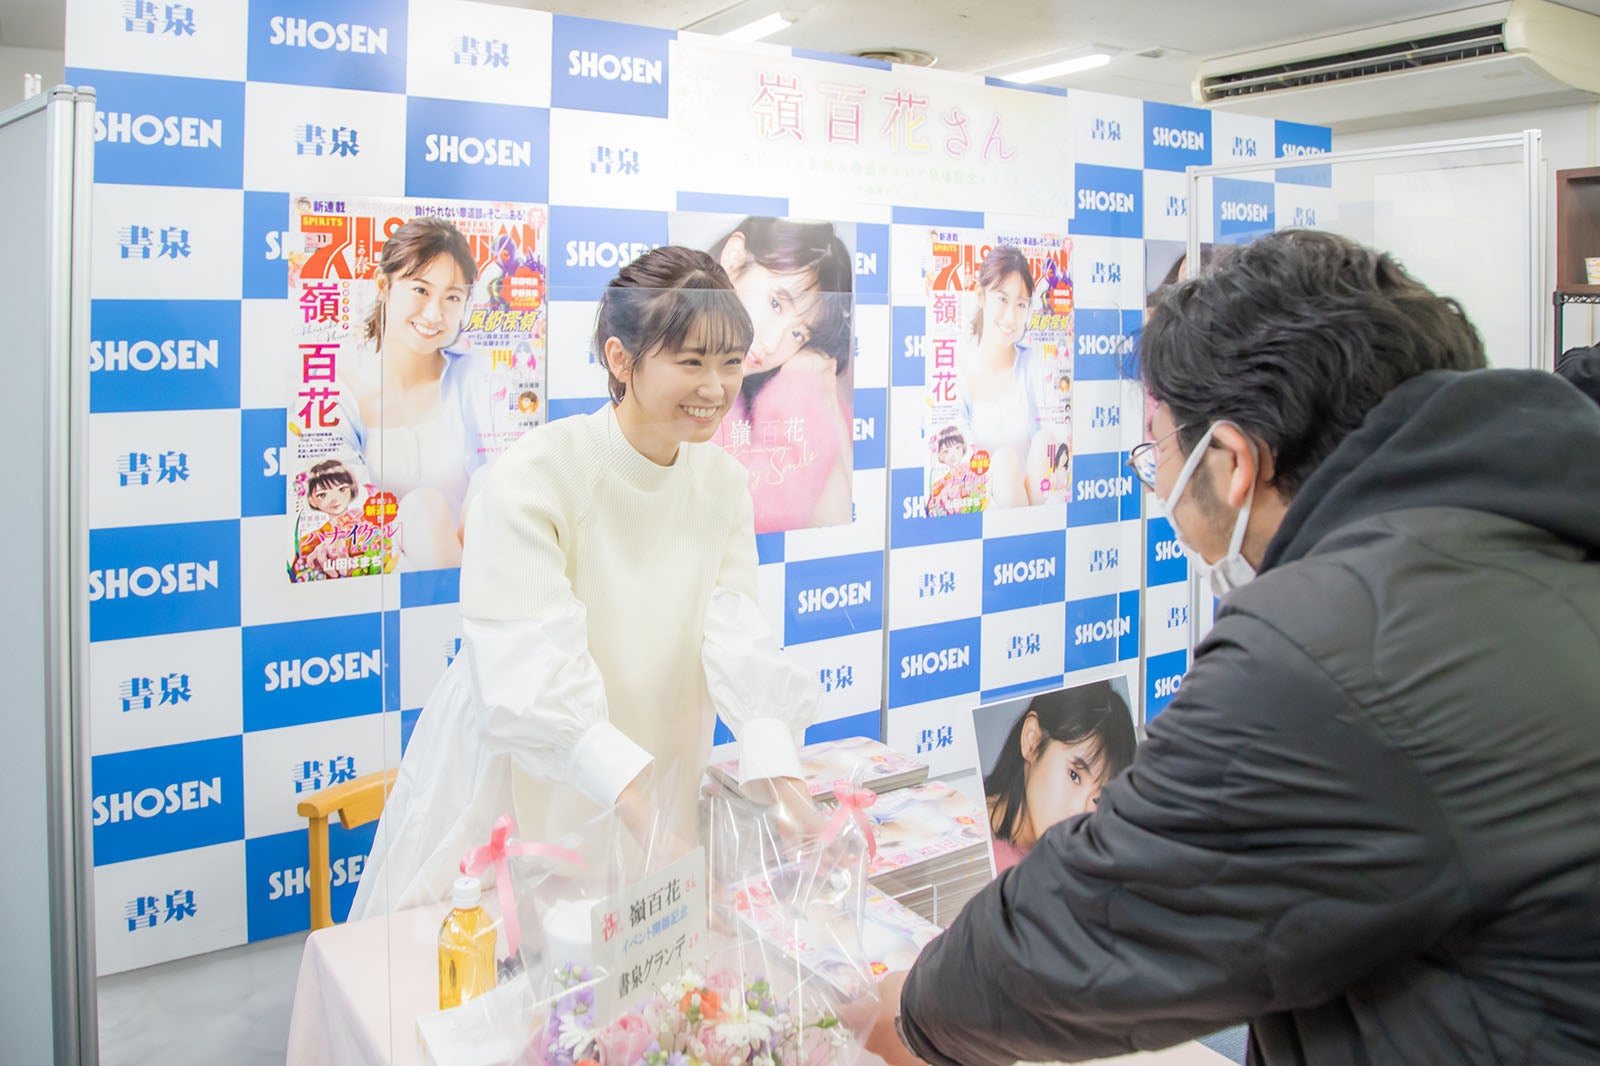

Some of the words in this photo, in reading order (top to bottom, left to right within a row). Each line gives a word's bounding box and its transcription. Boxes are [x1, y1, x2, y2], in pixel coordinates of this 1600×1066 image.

[121, 0, 196, 37] 書泉
[270, 15, 388, 56] SHOSEN
[451, 34, 510, 69] 書泉
[567, 50, 662, 87] SHOSEN
[93, 111, 222, 149] SHOSEN
[748, 71, 1017, 162] 嶺百花さん
[1091, 118, 1122, 142] 書泉
[293, 124, 360, 158] 書泉
[425, 134, 532, 168] SHOSEN
[1152, 126, 1205, 152] SHOSEN
[1232, 136, 1257, 158] 書泉
[1281, 143, 1328, 159] SHOS
[588, 145, 641, 177] 書泉
[1078, 190, 1135, 213] SHOSEN
[1220, 200, 1269, 223] SHOSEN
[303, 217, 343, 227] SPIRITS
[116, 225, 192, 260] 書泉
[566, 240, 661, 268] SHOSE
[1091, 263, 1122, 285] 書泉
[89, 339, 219, 372] SHOSEN
[297, 281, 342, 431] 嶺百花
[932, 292, 958, 403] 嶺百花
[1078, 335, 1135, 355] SHOSEN
[730, 416, 805, 448] 嶺百花
[1091, 405, 1121, 428] 書泉
[116, 450, 191, 488] 書泉
[1076, 475, 1133, 501] SHOSEN
[1089, 547, 1120, 571] 書泉
[1154, 539, 1187, 561] SHO
[89, 560, 219, 602] SHOSEN
[918, 570, 957, 598] 書泉
[993, 556, 1056, 586] SHOSEN
[797, 581, 871, 615] SHOSEN
[1006, 632, 1041, 660] 書泉
[1074, 615, 1131, 645] SHOSEN
[264, 648, 382, 693] SHOSEN
[901, 645, 970, 679] SHOSEN
[117, 672, 192, 713] 書泉
[1154, 675, 1184, 698] SHO
[916, 725, 954, 754] 書泉
[292, 755, 358, 794] 書泉
[92, 776, 222, 828] SHOSEN
[268, 854, 368, 901] SHSE
[124, 888, 198, 932] 書泉
[629, 877, 682, 928] 嶺百花
[618, 932, 687, 1000] 書泉グランデ
